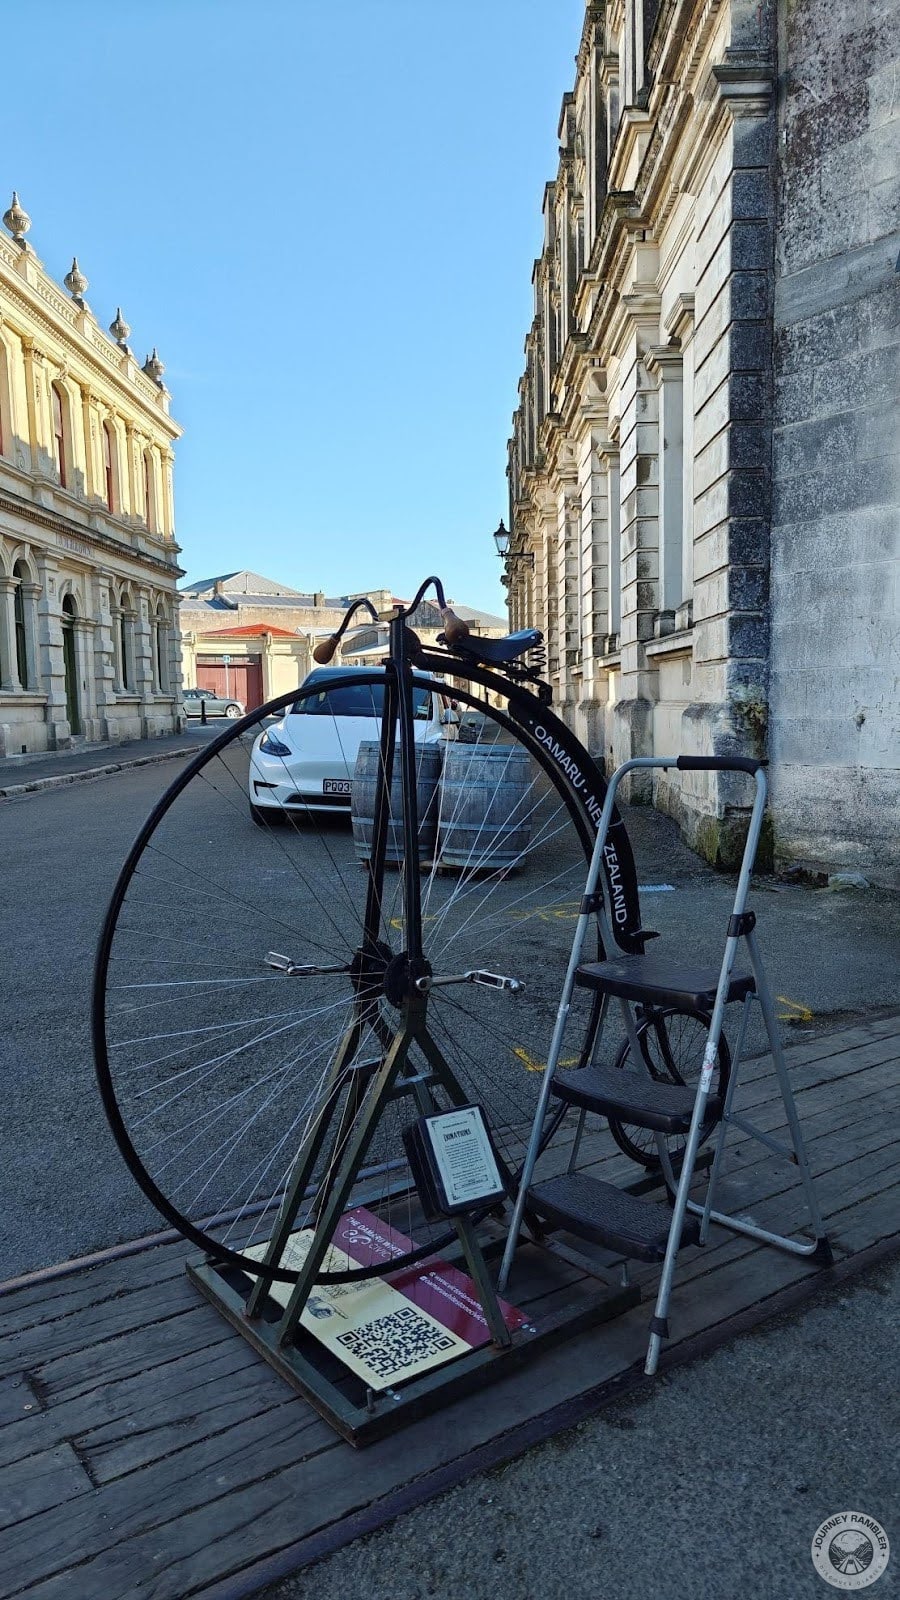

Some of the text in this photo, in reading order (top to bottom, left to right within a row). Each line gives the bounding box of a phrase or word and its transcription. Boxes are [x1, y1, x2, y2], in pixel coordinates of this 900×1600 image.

[534, 724, 587, 788] OAMARU
[603, 844, 628, 923] ZEALAND
[347, 1216, 361, 1227] THE
